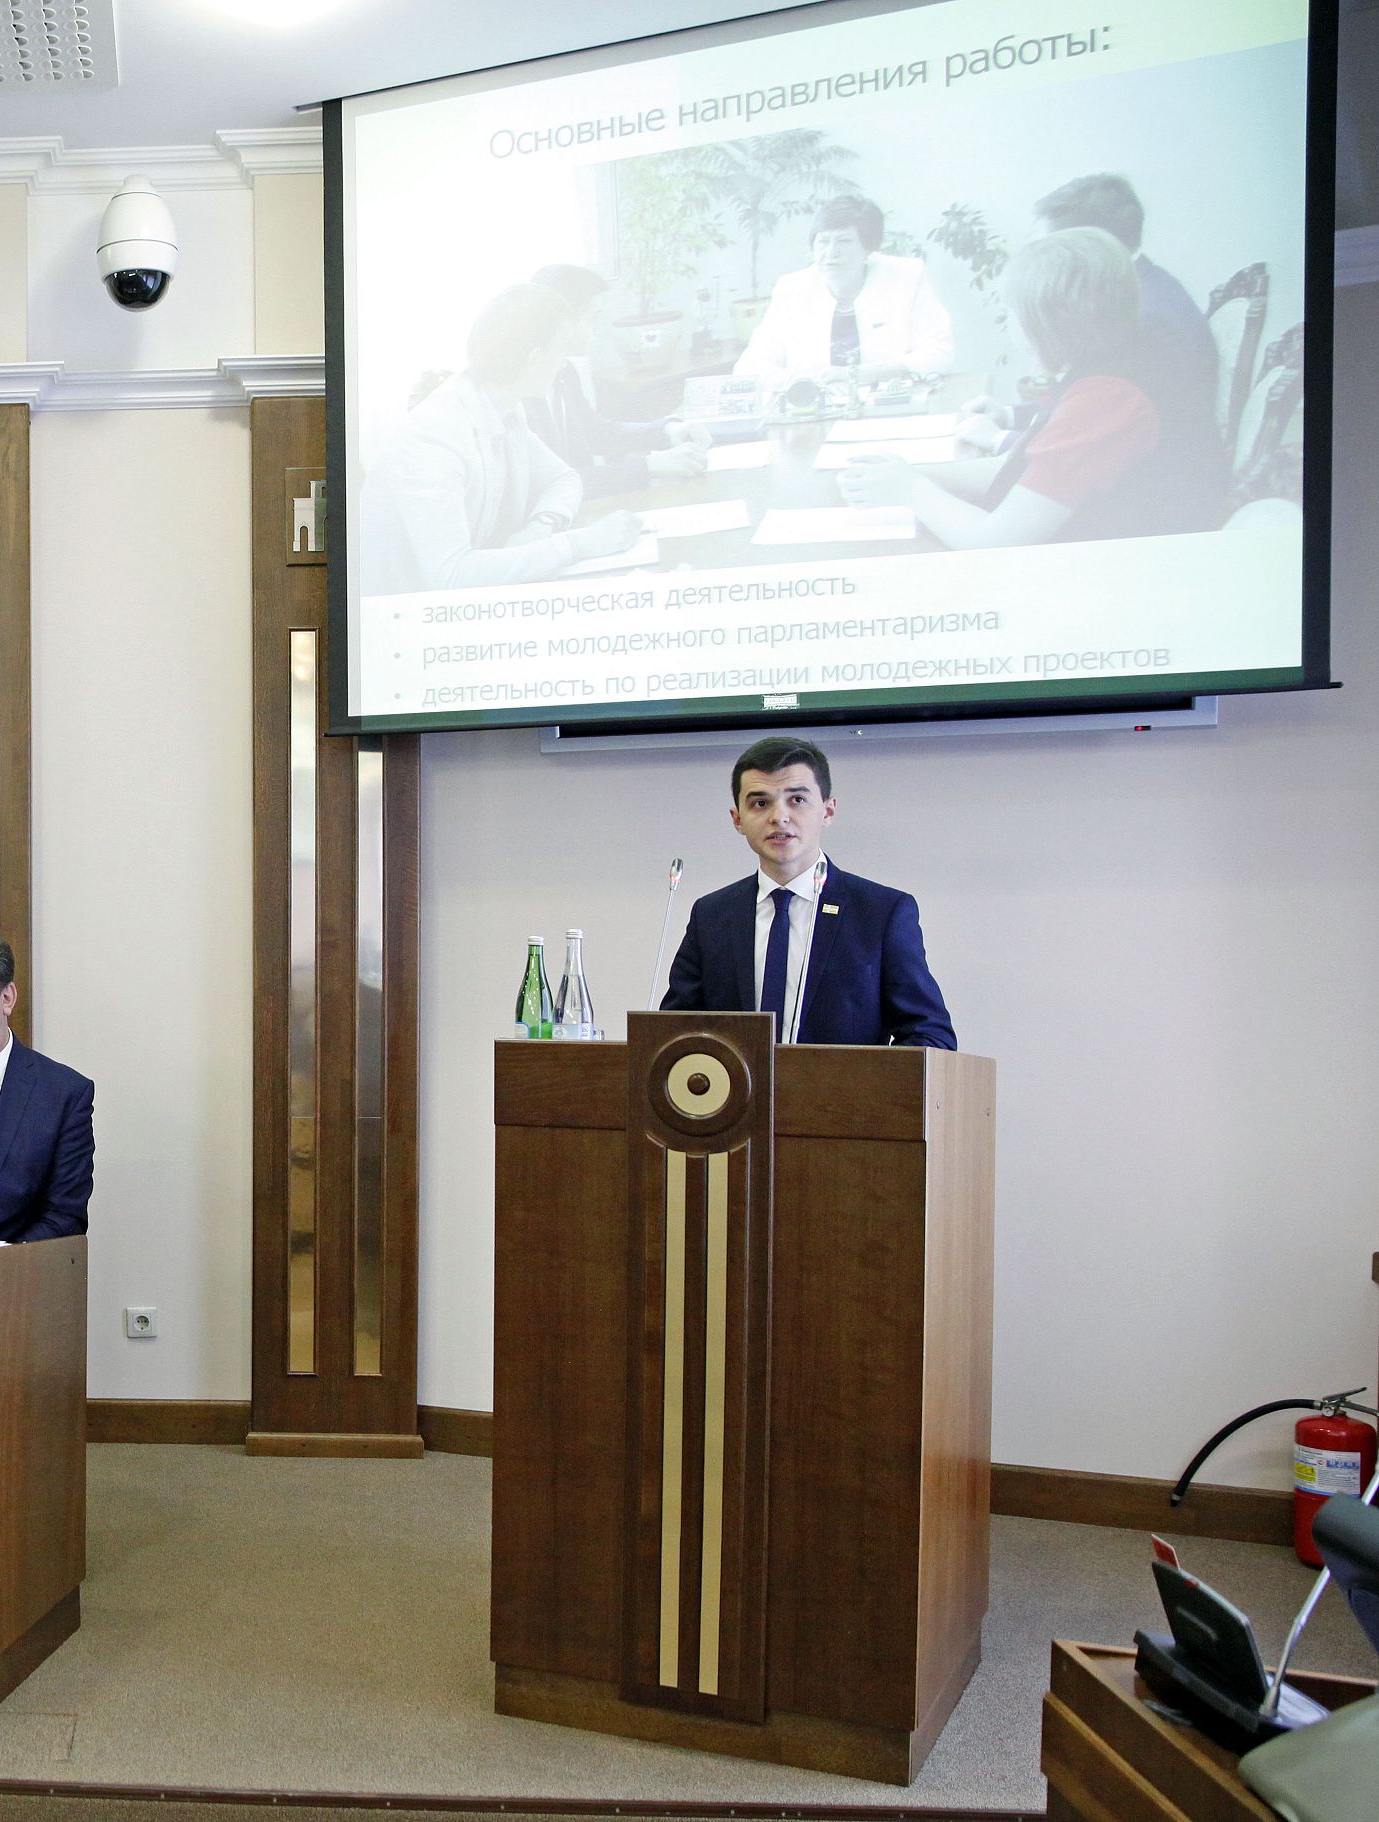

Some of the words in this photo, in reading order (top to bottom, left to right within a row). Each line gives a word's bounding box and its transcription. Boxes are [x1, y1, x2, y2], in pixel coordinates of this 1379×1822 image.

[489, 107, 667, 159] Основные
[678, 60, 928, 126] направления
[945, 25, 1110, 87] работы:
[422, 590, 654, 624] законотворческая
[665, 577, 856, 609] деятельность
[423, 640, 538, 670] развитие
[548, 628, 726, 656] молодежного
[737, 610, 999, 648] парламентаризма
[422, 678, 594, 707] деятельность
[606, 676, 636, 695] по
[647, 666, 810, 697] реализации
[821, 656, 1013, 683] молодежных
[1024, 649, 1171, 677] проектов
